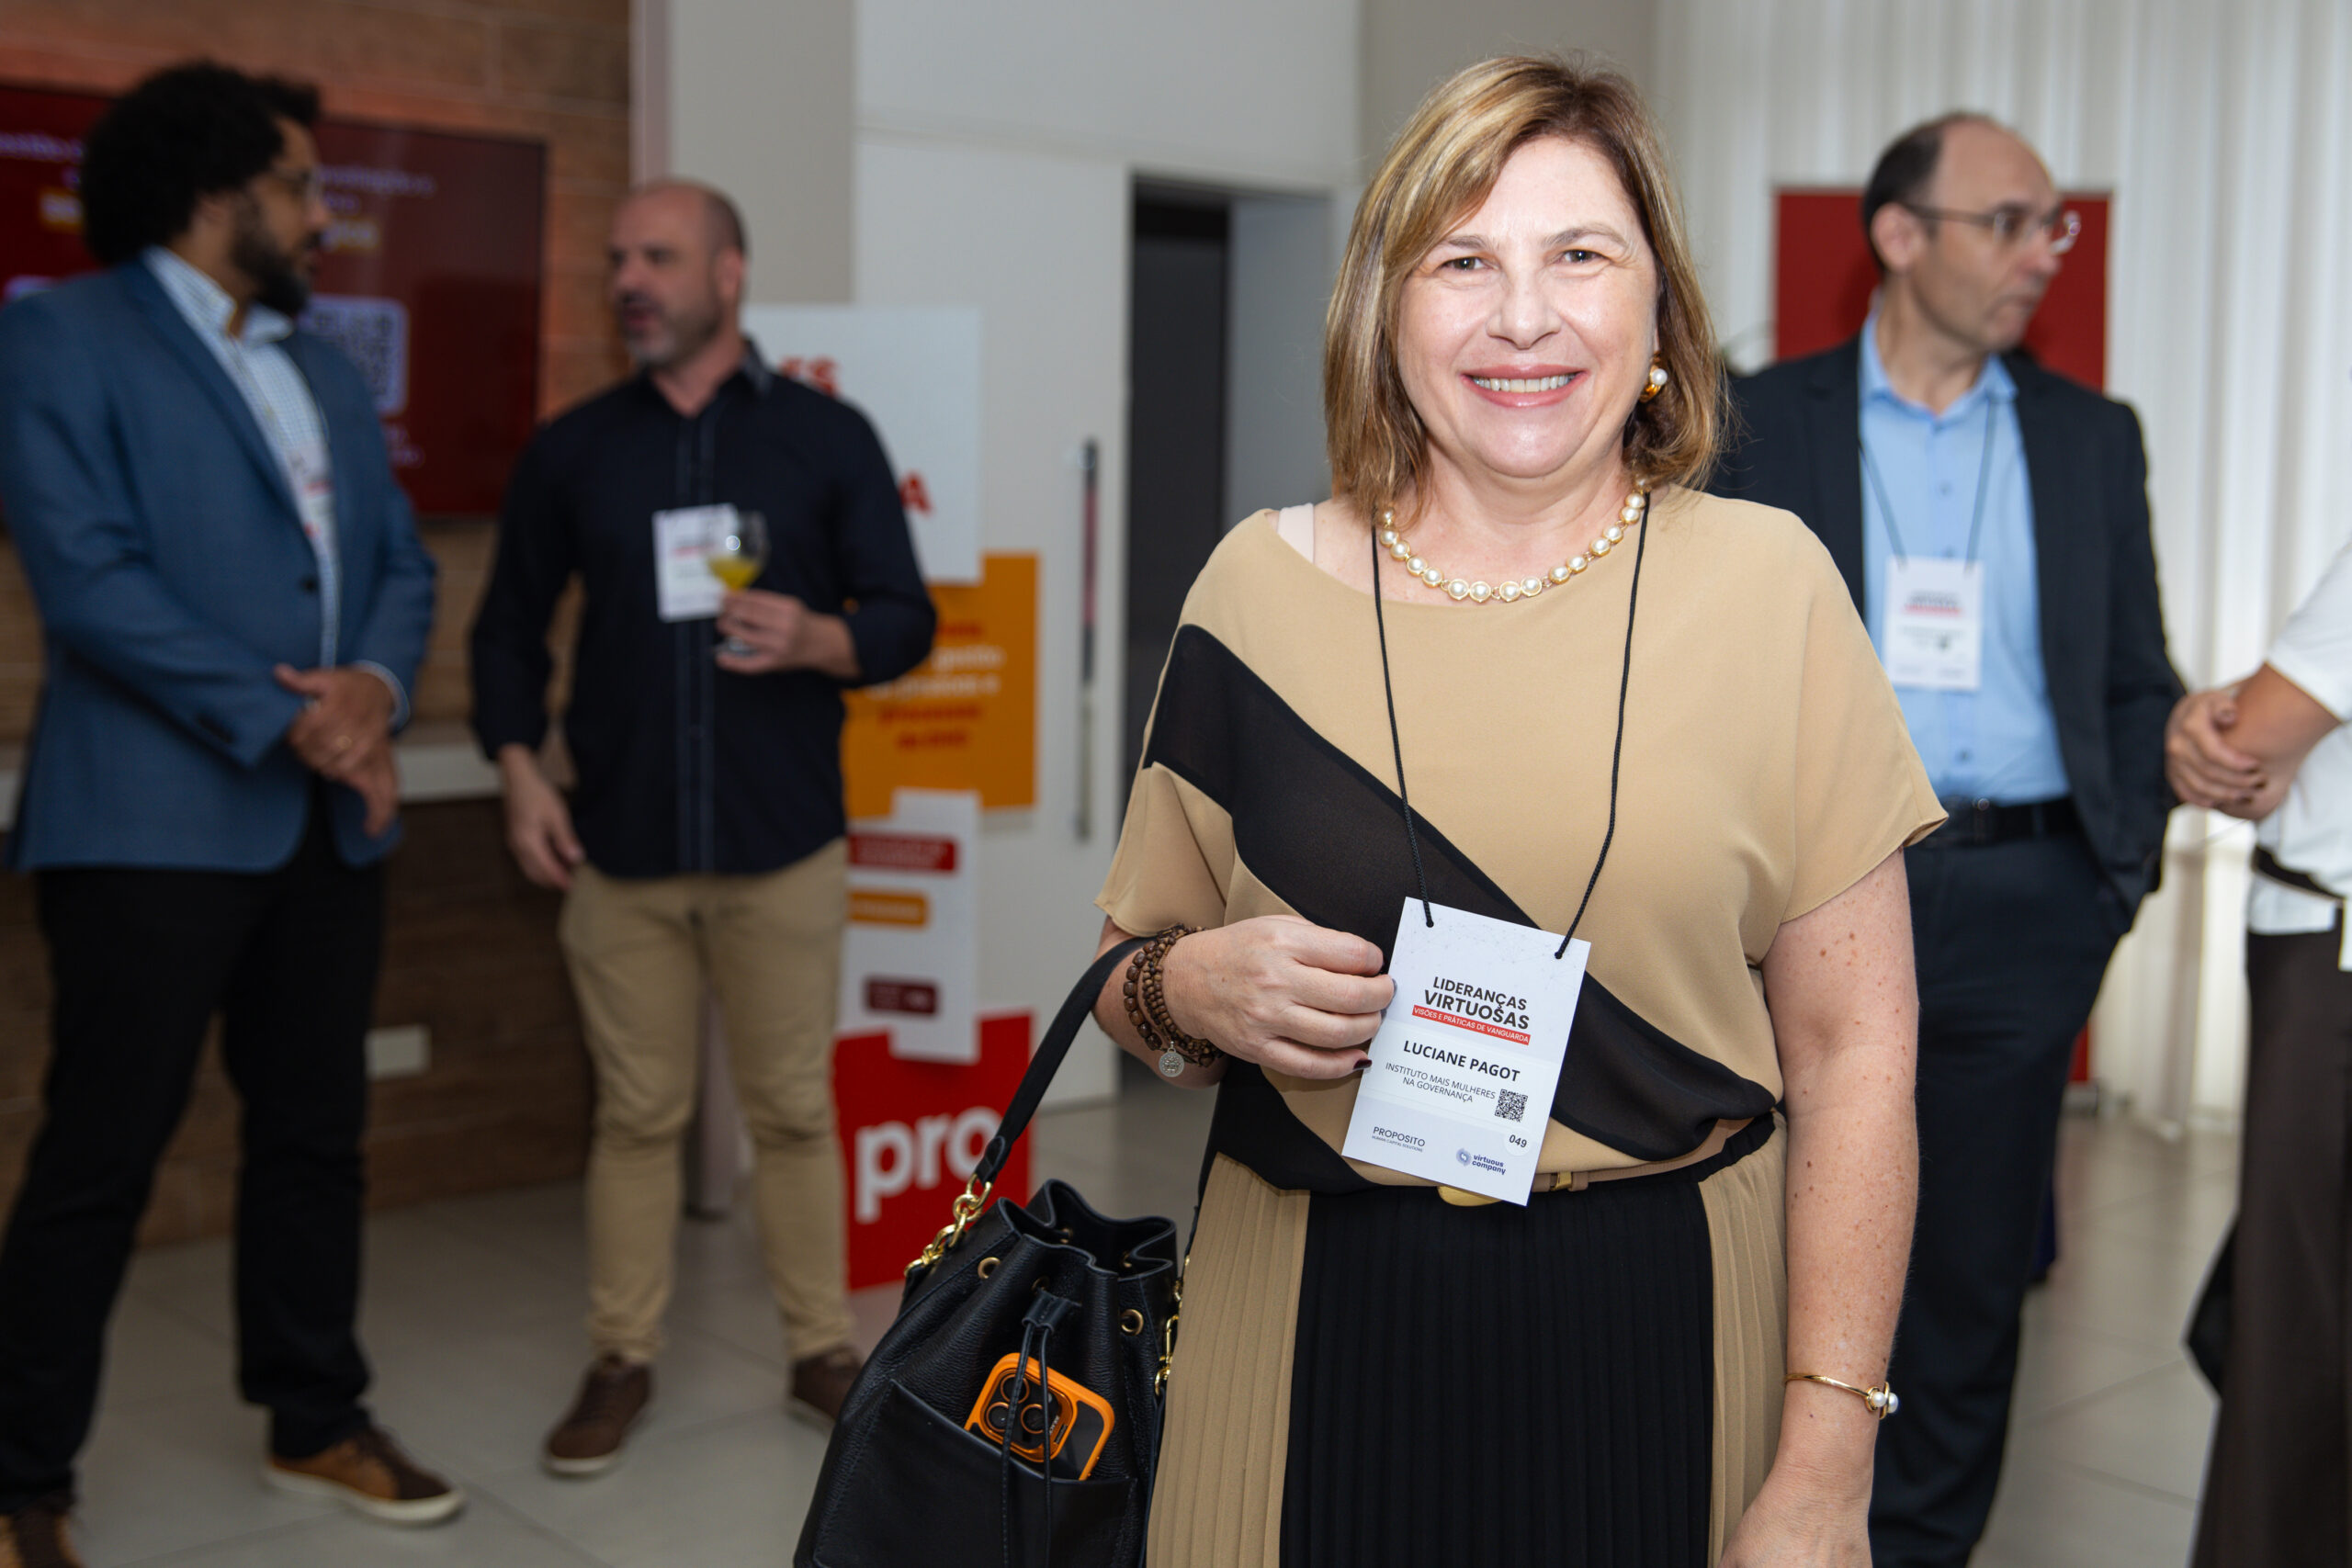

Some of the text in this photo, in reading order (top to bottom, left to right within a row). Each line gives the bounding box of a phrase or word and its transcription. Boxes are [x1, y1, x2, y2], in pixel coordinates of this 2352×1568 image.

[1425, 989, 1530, 1030] VIRTUOSAS
[1433, 976, 1527, 1010] LIDERANÇAS
[1414, 1007, 1437, 1019] VISÕES
[1443, 1014, 1476, 1029] PRÁTICAS
[1476, 1022, 1486, 1032] DE
[1487, 1025, 1529, 1043] VANGUARDA
[1403, 1040, 1521, 1082] LUCIANE PAGOT
[1385, 1062, 1497, 1100] INSTITUTO MAIS MULHERES
[1402, 1077, 1474, 1103] NA GOVERNANÇA
[1373, 1126, 1426, 1147] PROPOSITO
[1509, 1134, 1528, 1148] 049
[854, 1105, 1001, 1224] pro
[1472, 1160, 1507, 1176] company
[1473, 1155, 1504, 1168] virtuous
